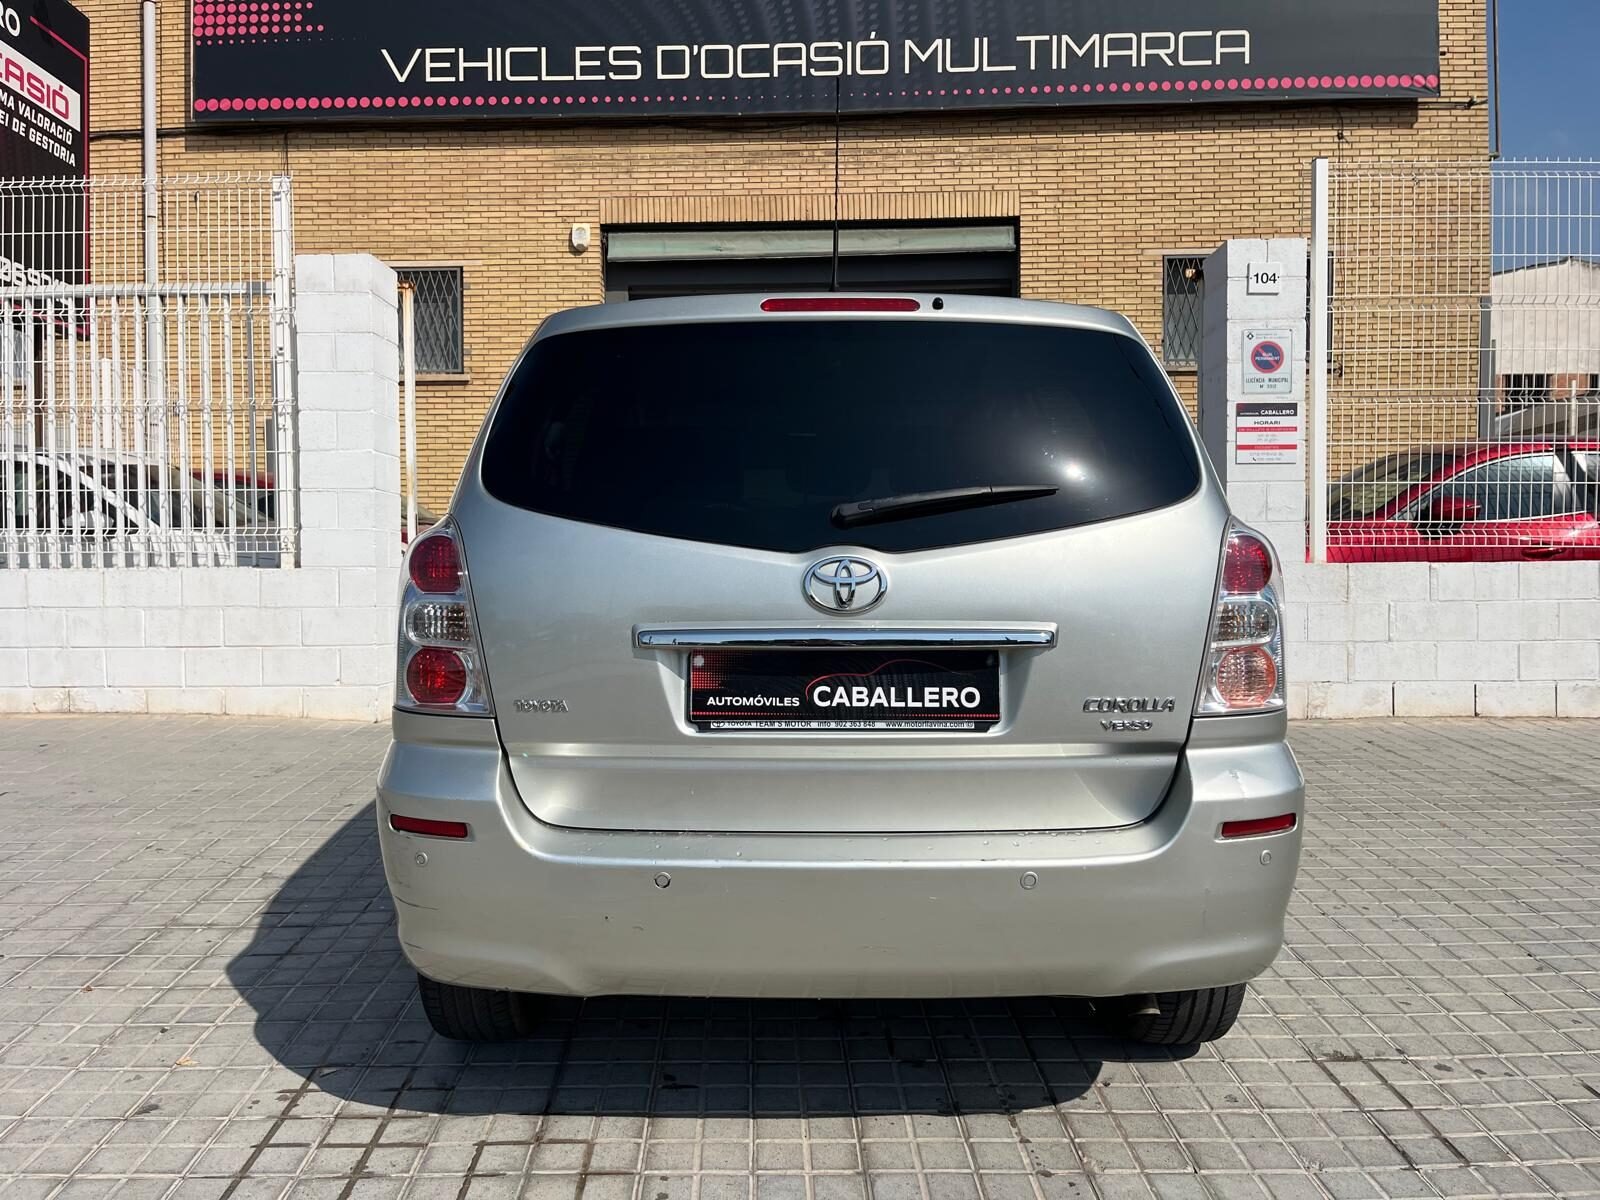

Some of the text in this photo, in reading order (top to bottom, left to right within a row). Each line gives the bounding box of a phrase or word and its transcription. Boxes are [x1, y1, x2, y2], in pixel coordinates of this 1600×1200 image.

[380, 45, 642, 83] VEHICLES
[903, 29, 1251, 74] MULTIMARCA
[0, 52, 69, 120] ASIÓ
[18, 100, 73, 145] VALORACIÓ
[12, 117, 27, 137] DE
[29, 127, 76, 167] GESTORIA
[1253, 272, 1278, 284] 104
[513, 698, 569, 713] TOYOTA
[706, 685, 982, 709] AUTOMÓVILES CABALLERO
[1082, 696, 1176, 713] COROLLA
[784, 720, 812, 728] MOTOR
[1099, 719, 1153, 732] VERSO
